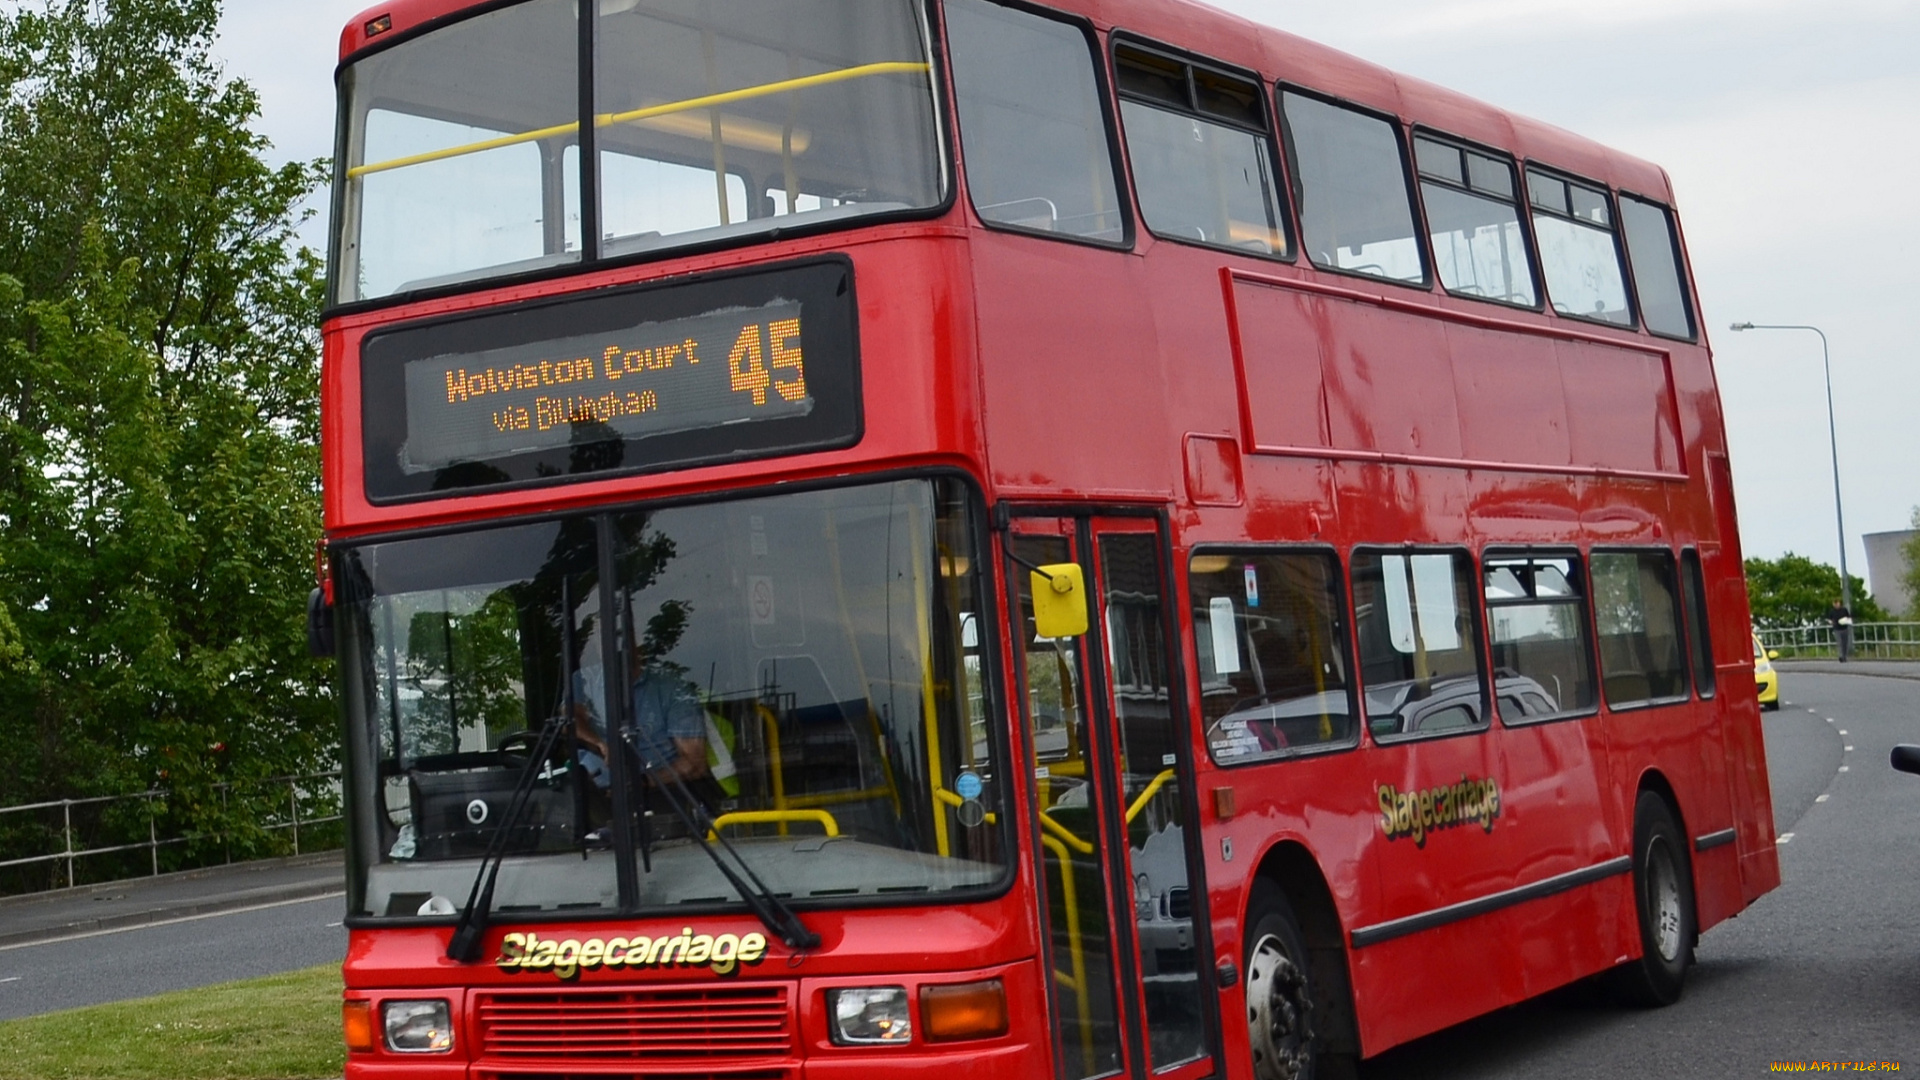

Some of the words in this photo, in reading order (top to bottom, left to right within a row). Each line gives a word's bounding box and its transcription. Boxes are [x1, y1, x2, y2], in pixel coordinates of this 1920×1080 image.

[445, 356, 595, 404] Wolviston
[603, 338, 701, 380] Court
[728, 317, 807, 406] 45
[492, 405, 531, 432] via
[535, 389, 658, 431] Billingham
[1377, 773, 1499, 844] Stagecarriage
[495, 926, 767, 980] Stagecarriage
